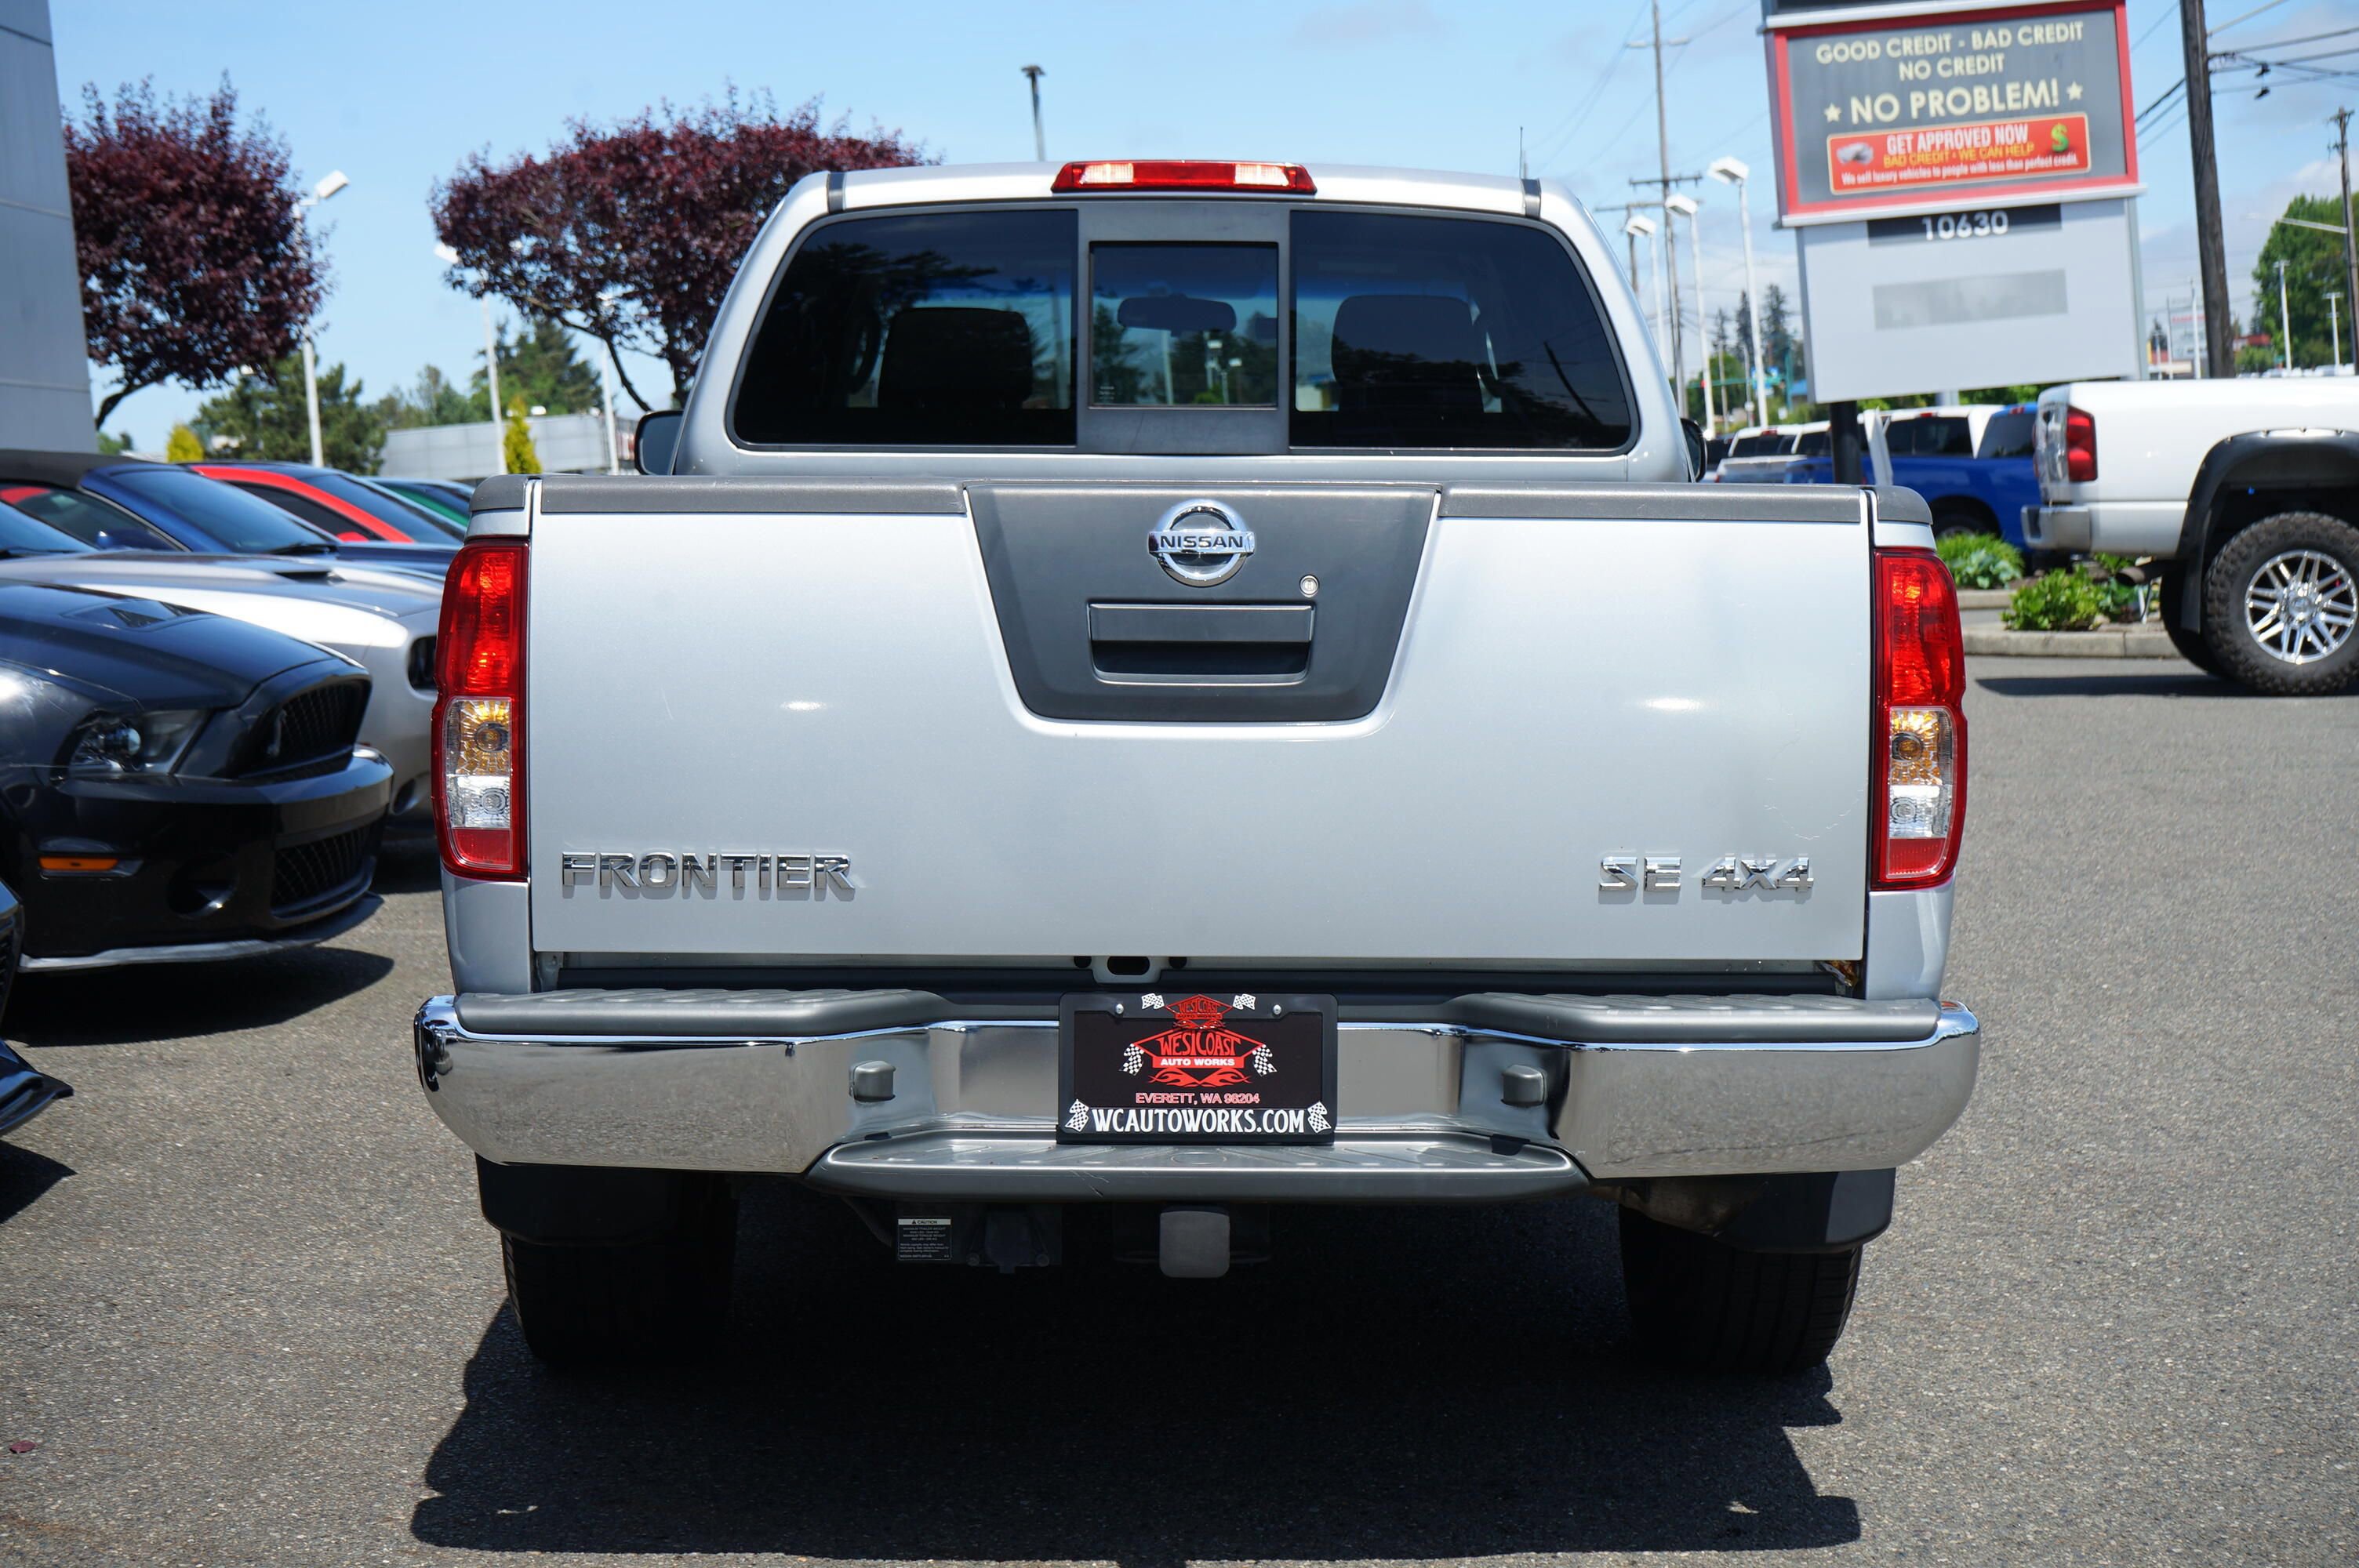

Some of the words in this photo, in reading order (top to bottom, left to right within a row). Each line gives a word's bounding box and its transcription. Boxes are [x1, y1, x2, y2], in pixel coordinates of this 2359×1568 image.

[1816, 40, 1881, 65] GOOD
[1886, 33, 1952, 58] CREDIT
[1971, 27, 2012, 51] BAD
[2017, 21, 2084, 46] CREDIT
[1899, 60, 1932, 82] NO
[1936, 53, 2005, 78] CREDIT
[1850, 93, 1900, 125] NO
[1910, 78, 2059, 119] PROBLEM!
[1883, 154, 1907, 169] BAD
[1909, 149, 1950, 166] CREDIT
[1959, 147, 1977, 162] WE
[1979, 144, 2003, 160] CAN
[2005, 141, 2035, 158] HELP
[1886, 132, 1914, 156] GET
[1917, 125, 1991, 154] APPROVED
[1994, 123, 2029, 146] NOW
[1841, 172, 1856, 186] We
[1873, 169, 1898, 183] luxury
[1899, 166, 1932, 180] vehicles
[1932, 165, 1941, 177] to
[1942, 162, 1968, 179] people
[1969, 160, 1987, 174] with
[1988, 159, 2005, 172] less
[2006, 158, 2023, 171] than
[2025, 154, 2052, 172] perfect
[1921, 210, 2008, 241] 10630
[1161, 535, 1243, 548] NISSAN
[562, 851, 856, 889] FRONTIER
[1599, 856, 1681, 891] SE
[1136, 1092, 1198, 1105] EVERETT,
[1200, 1093, 1223, 1104] WA
[1224, 1093, 1260, 1104] 98204
[1092, 1108, 1305, 1134] WCAUTOWORKS.COM
